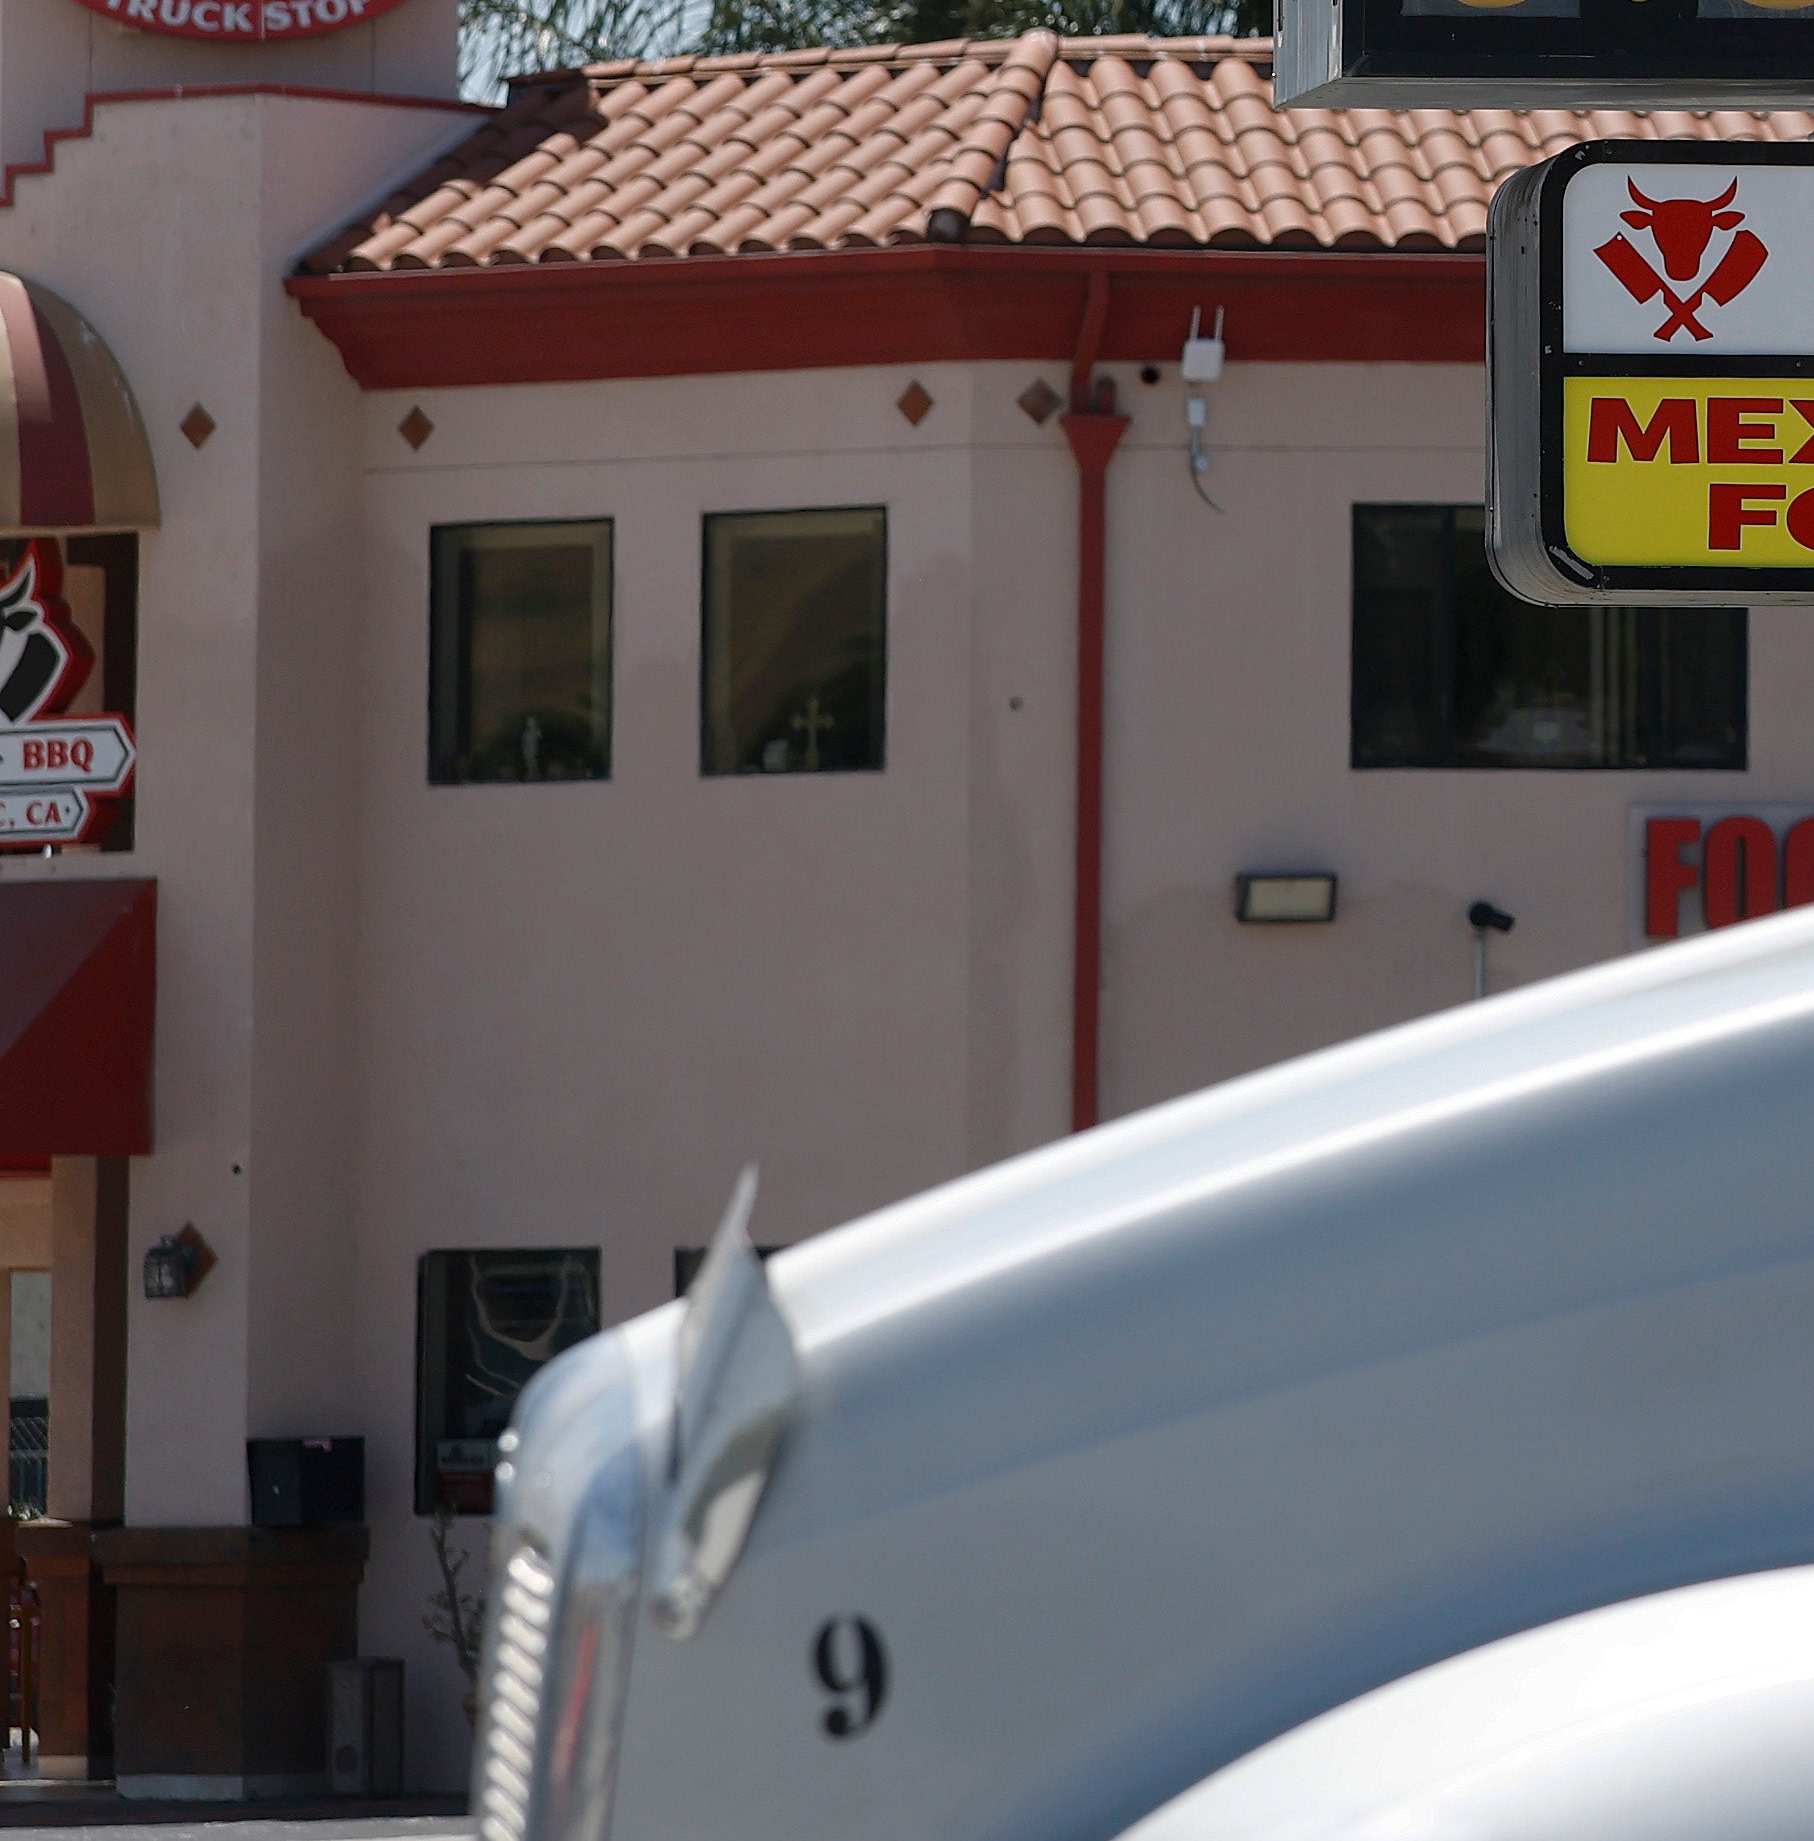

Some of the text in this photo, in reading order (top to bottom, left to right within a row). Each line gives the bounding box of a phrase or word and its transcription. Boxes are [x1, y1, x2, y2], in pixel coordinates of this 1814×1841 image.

[23, 739, 94, 774] BBQ
[26, 801, 62, 825] CA
[812, 1614, 889, 1739] 9
